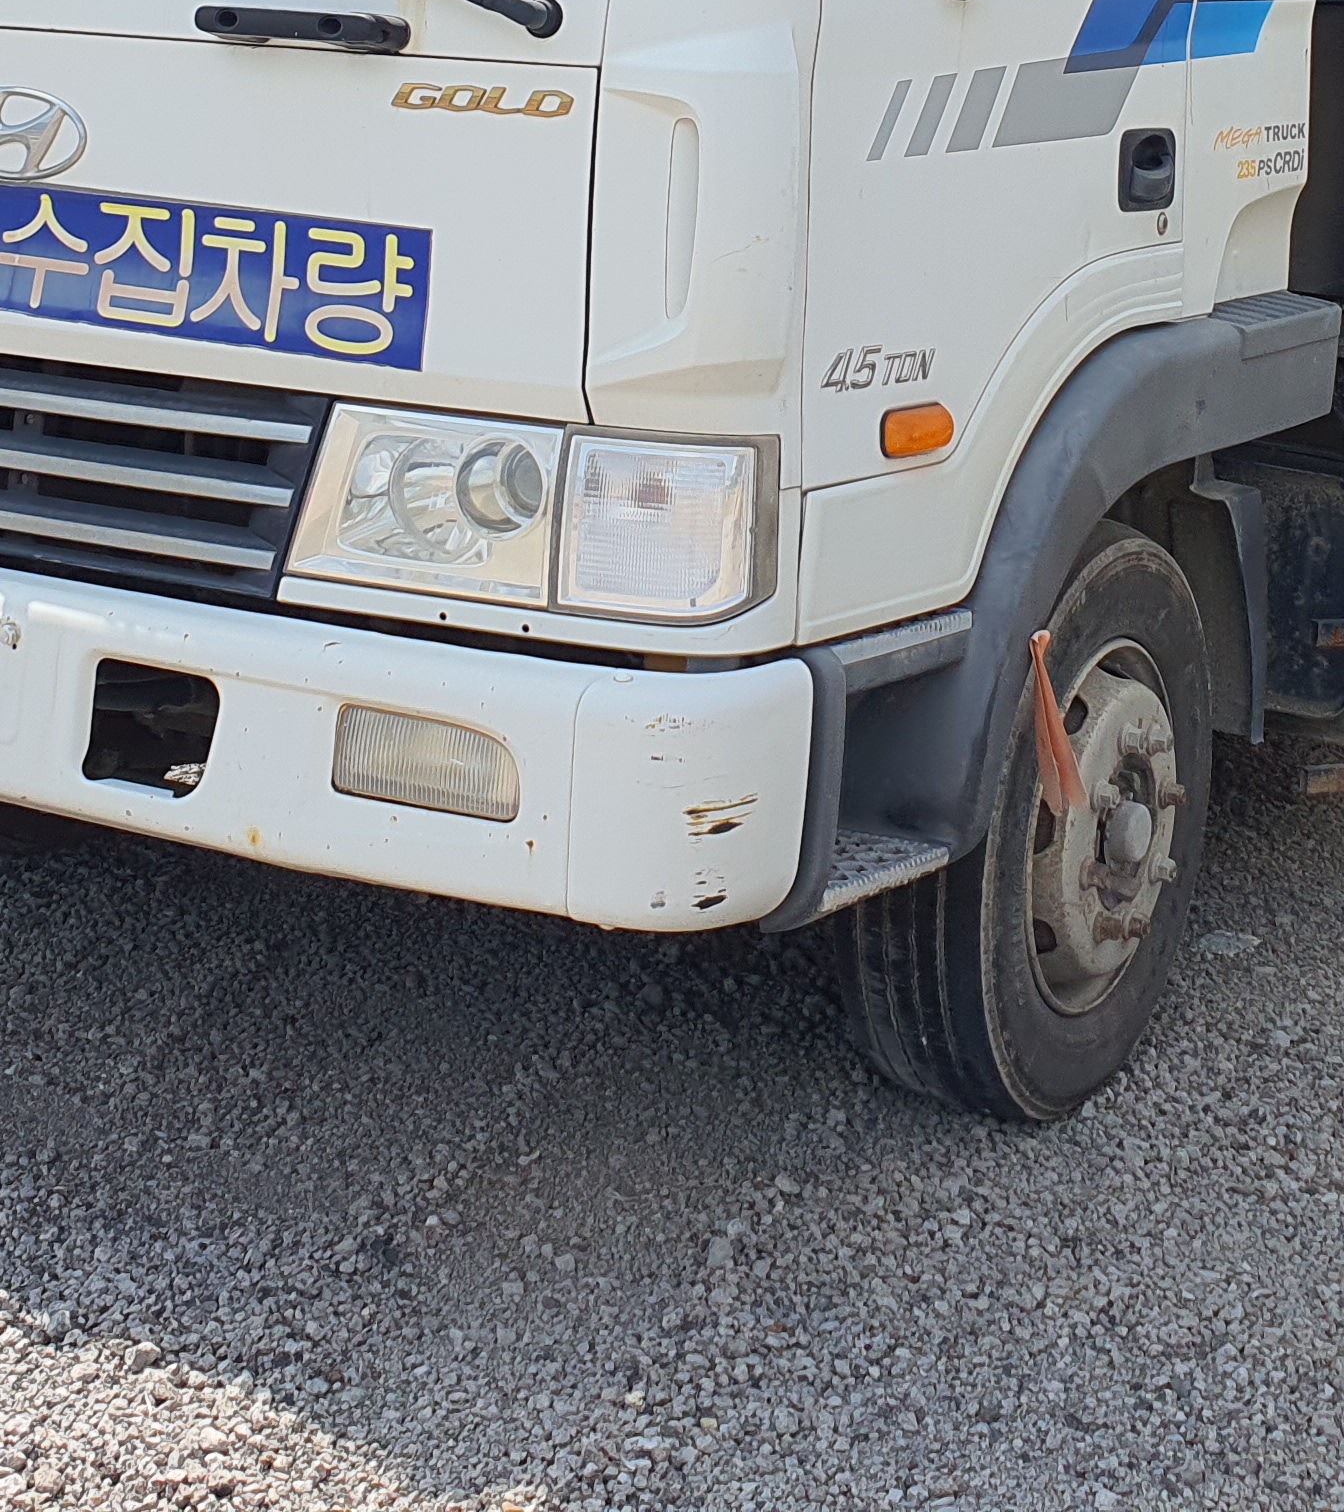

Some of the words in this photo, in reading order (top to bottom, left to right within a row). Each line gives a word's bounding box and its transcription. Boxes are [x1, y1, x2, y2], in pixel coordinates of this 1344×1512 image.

[391, 82, 575, 118] GOLD
[1213, 125, 1263, 150] MEGA
[1264, 122, 1307, 143] TRUCK
